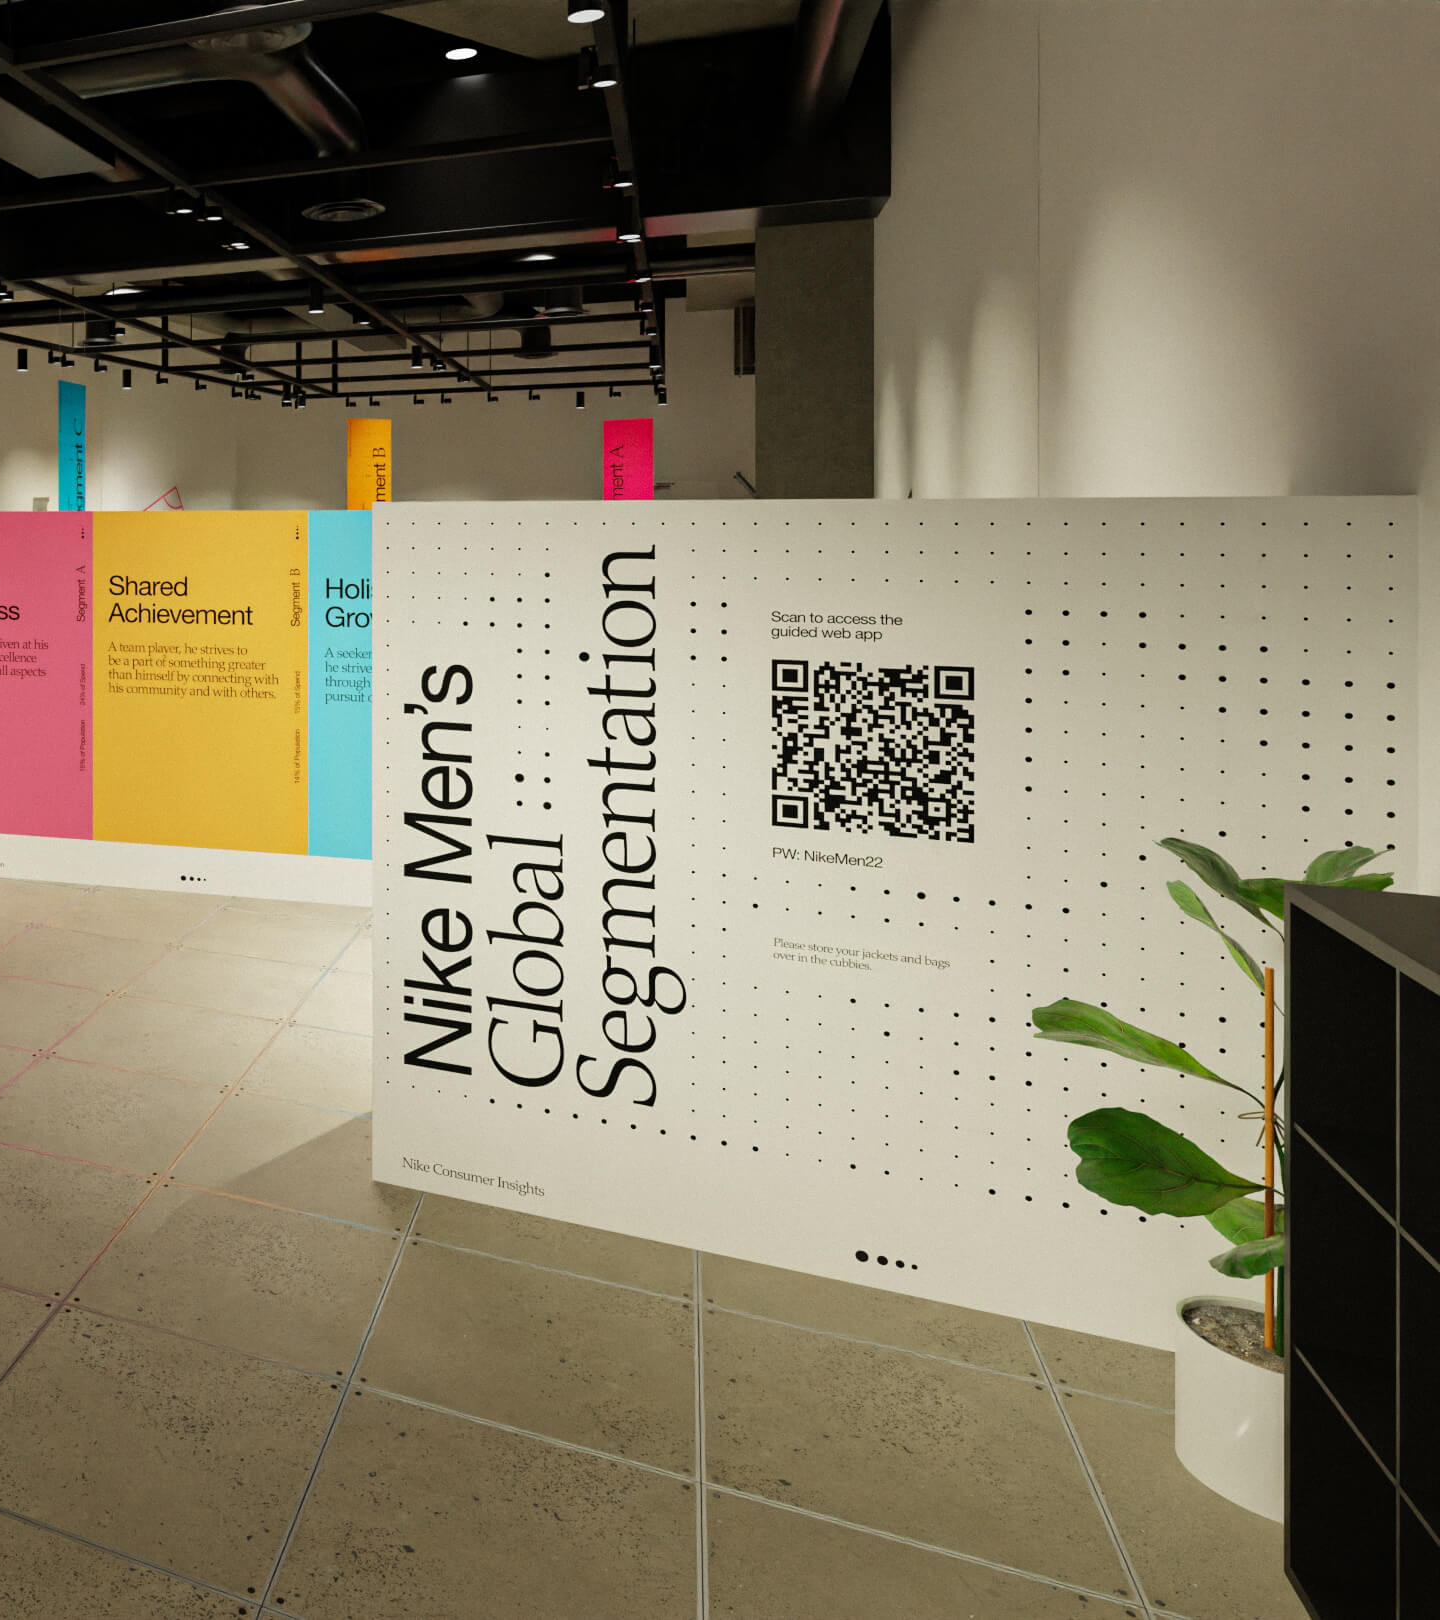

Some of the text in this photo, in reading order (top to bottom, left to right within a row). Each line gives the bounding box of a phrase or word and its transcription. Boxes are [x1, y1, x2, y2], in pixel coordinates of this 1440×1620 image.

[374, 464, 386, 502] ment
[610, 464, 624, 500] ment
[76, 565, 88, 622] Segment A
[109, 576, 188, 596] Shared
[326, 578, 372, 600] Holi
[290, 568, 303, 627] Segment B
[109, 603, 253, 625] Achievement
[325, 606, 372, 628] Gro
[771, 611, 903, 625] Scan to access the
[22, 641, 32, 649] at
[34, 639, 48, 649] his
[771, 626, 882, 642] guided web app
[108, 641, 247, 657] A team player, he strives to
[576, 544, 686, 1107] Segmentation
[773, 847, 883, 868] PW: NikeMen22
[404, 663, 473, 1076] Nike Men's
[486, 834, 564, 1087] Global
[773, 953, 872, 971] over in the cubbies.
[774, 937, 950, 970] Please store your jackets and bags
[402, 1157, 544, 1196] Nike Consumer Insights
